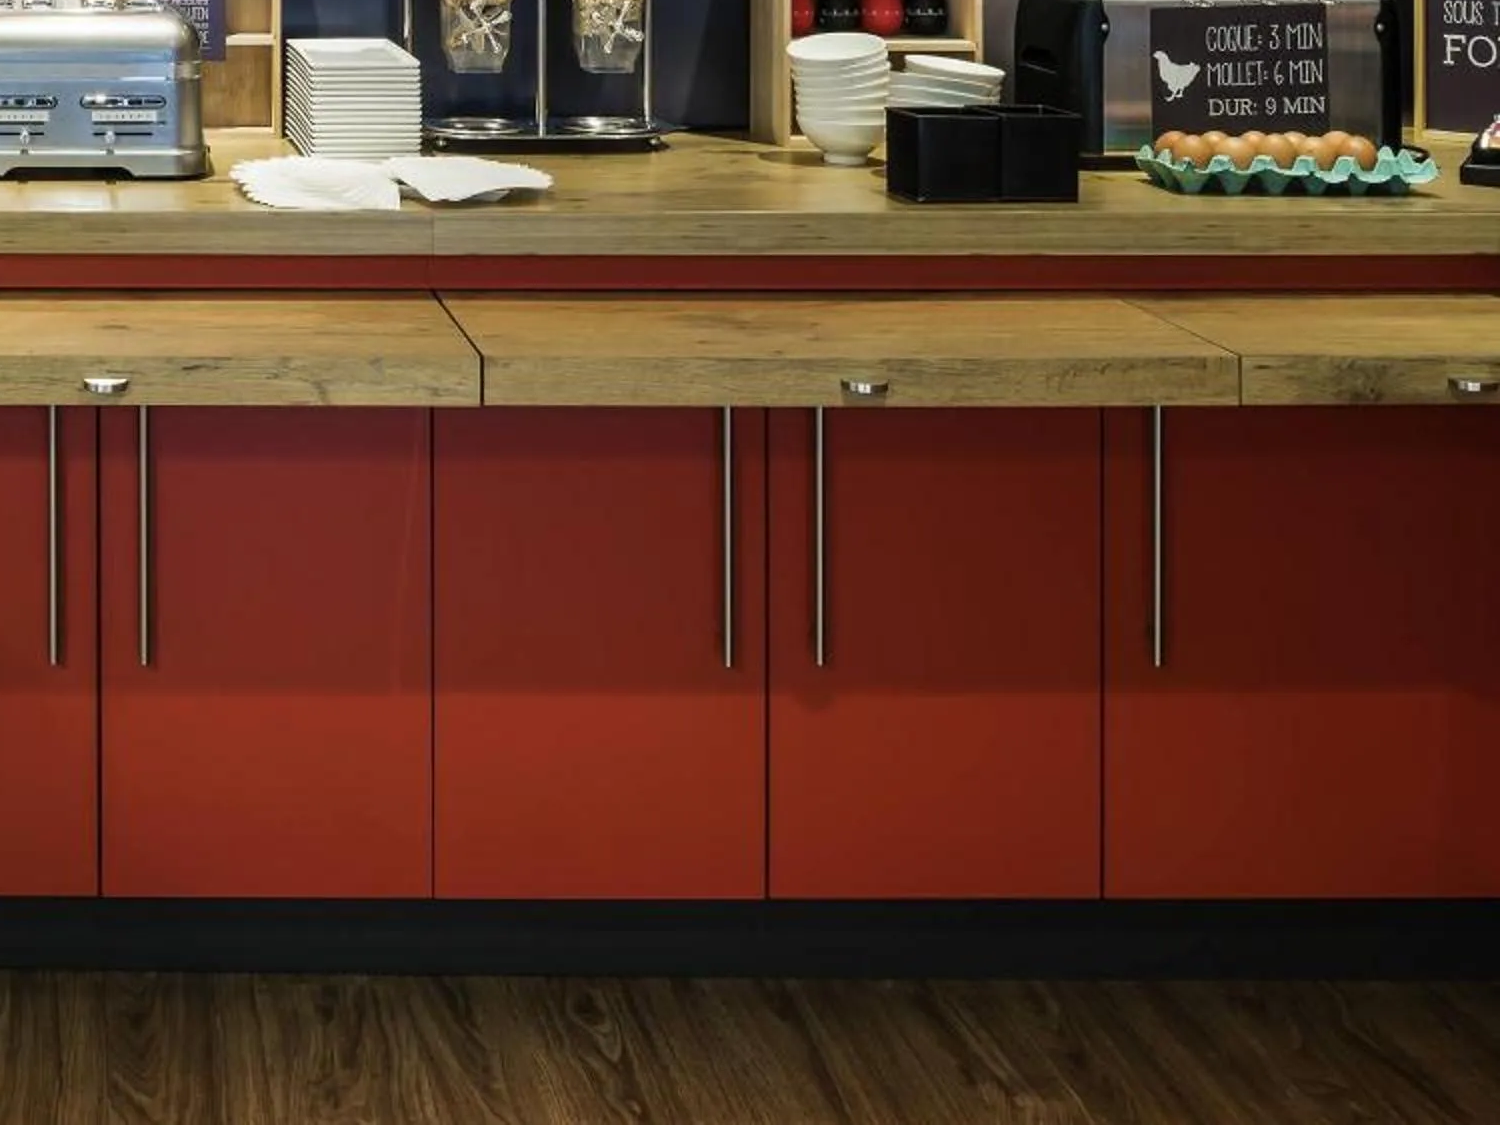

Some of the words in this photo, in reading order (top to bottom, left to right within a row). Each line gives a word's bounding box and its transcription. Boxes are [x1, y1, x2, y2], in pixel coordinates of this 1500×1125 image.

[1443, 0, 1485, 25] SOUS
[1269, 24, 1280, 50] 3
[1285, 22, 1323, 50] MIN
[1443, 34, 1500, 68] FO
[1207, 60, 1268, 87] MOLLET:
[1273, 60, 1285, 86] 6
[1288, 58, 1323, 85] MIN
[1208, 98, 1258, 116] DUR:
[1265, 96, 1277, 116] 9
[1283, 96, 1326, 115] MIN
